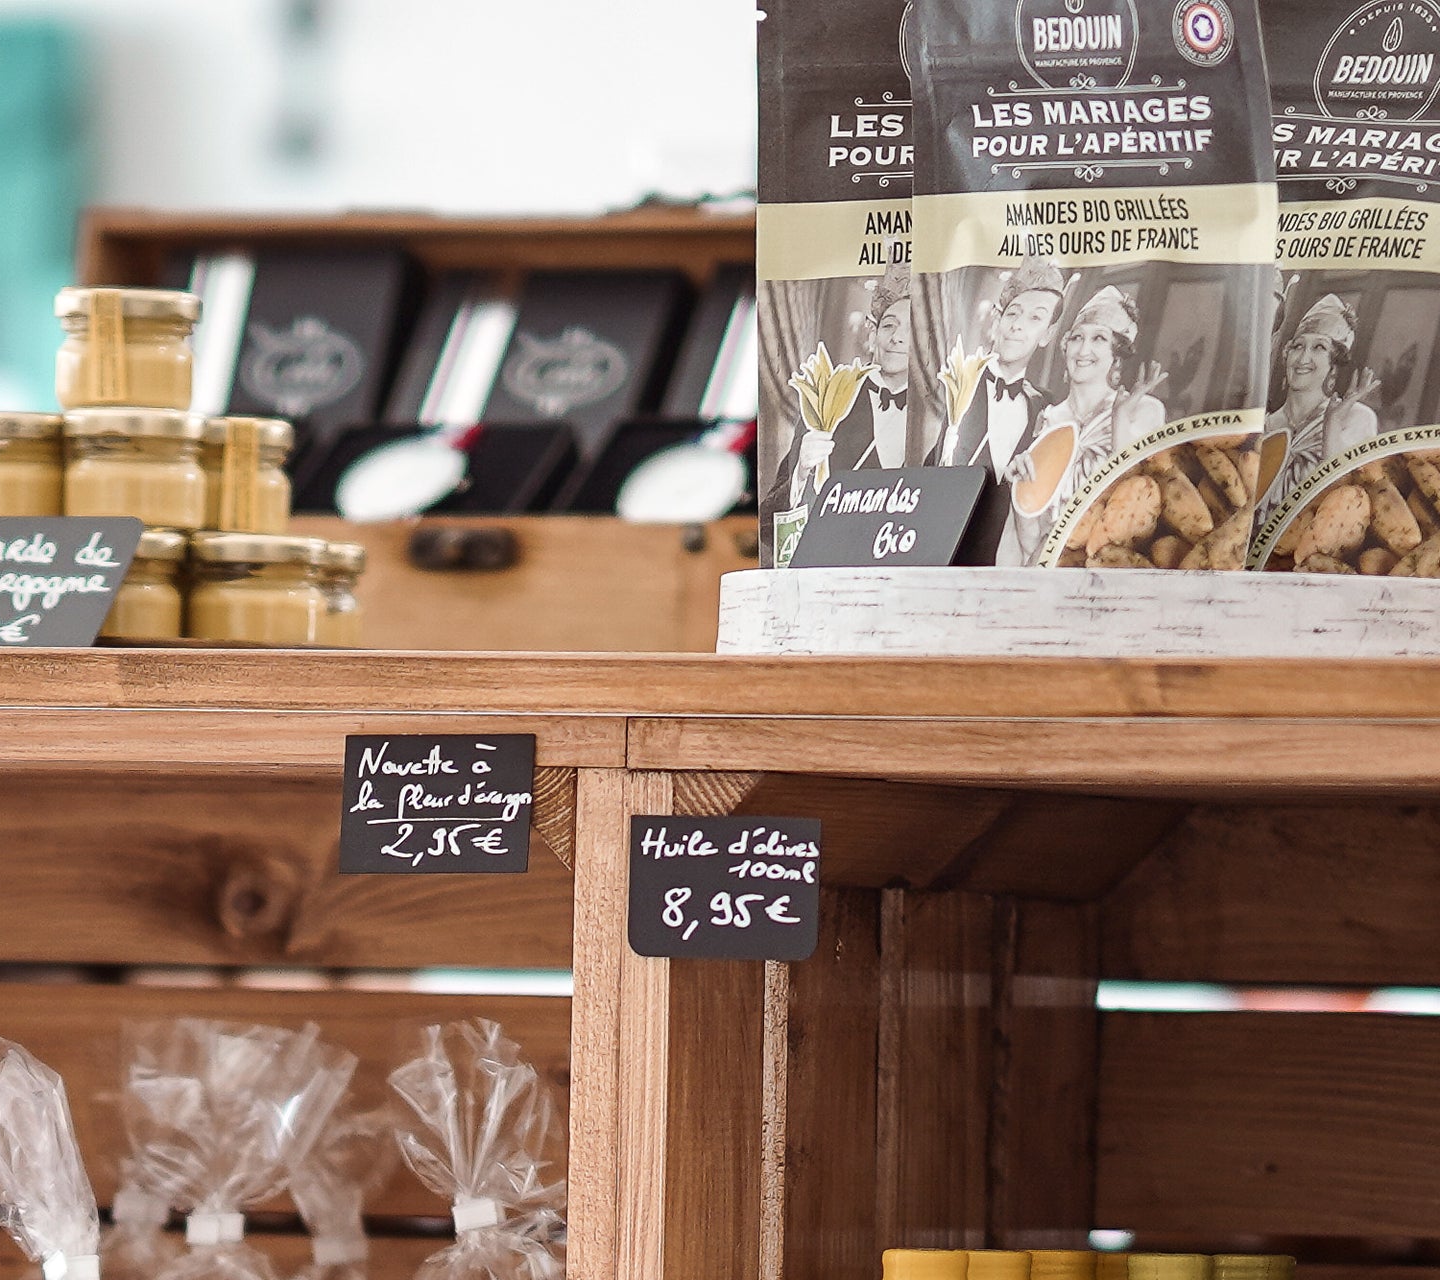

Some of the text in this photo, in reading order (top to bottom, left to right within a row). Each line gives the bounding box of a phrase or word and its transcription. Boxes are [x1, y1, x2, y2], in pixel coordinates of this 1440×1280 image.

[1034, 15, 1122, 53] BEDOUIN
[1331, 53, 1434, 84] BEDOUIN
[829, 114, 904, 139] LES
[971, 95, 1213, 129] LES MARIAGES
[972, 125, 1213, 158] POUR L'APÉRITIF
[1006, 193, 1189, 227] AMANDES GRILLÉES
[1025, 226, 1199, 256] DES OURS FRANCE
[1335, 236, 1354, 258] DE
[1131, 412, 1243, 457] VIERGE EXTRA
[820, 478, 921, 515] Amandes
[74, 532, 120, 568] de
[872, 521, 917, 560] Bio
[358, 741, 498, 779] Navette à
[380, 822, 509, 867] 2,95€
[641, 827, 719, 857] Huile
[728, 859, 817, 884] 100ml
[661, 887, 801, 940] 8,95€
